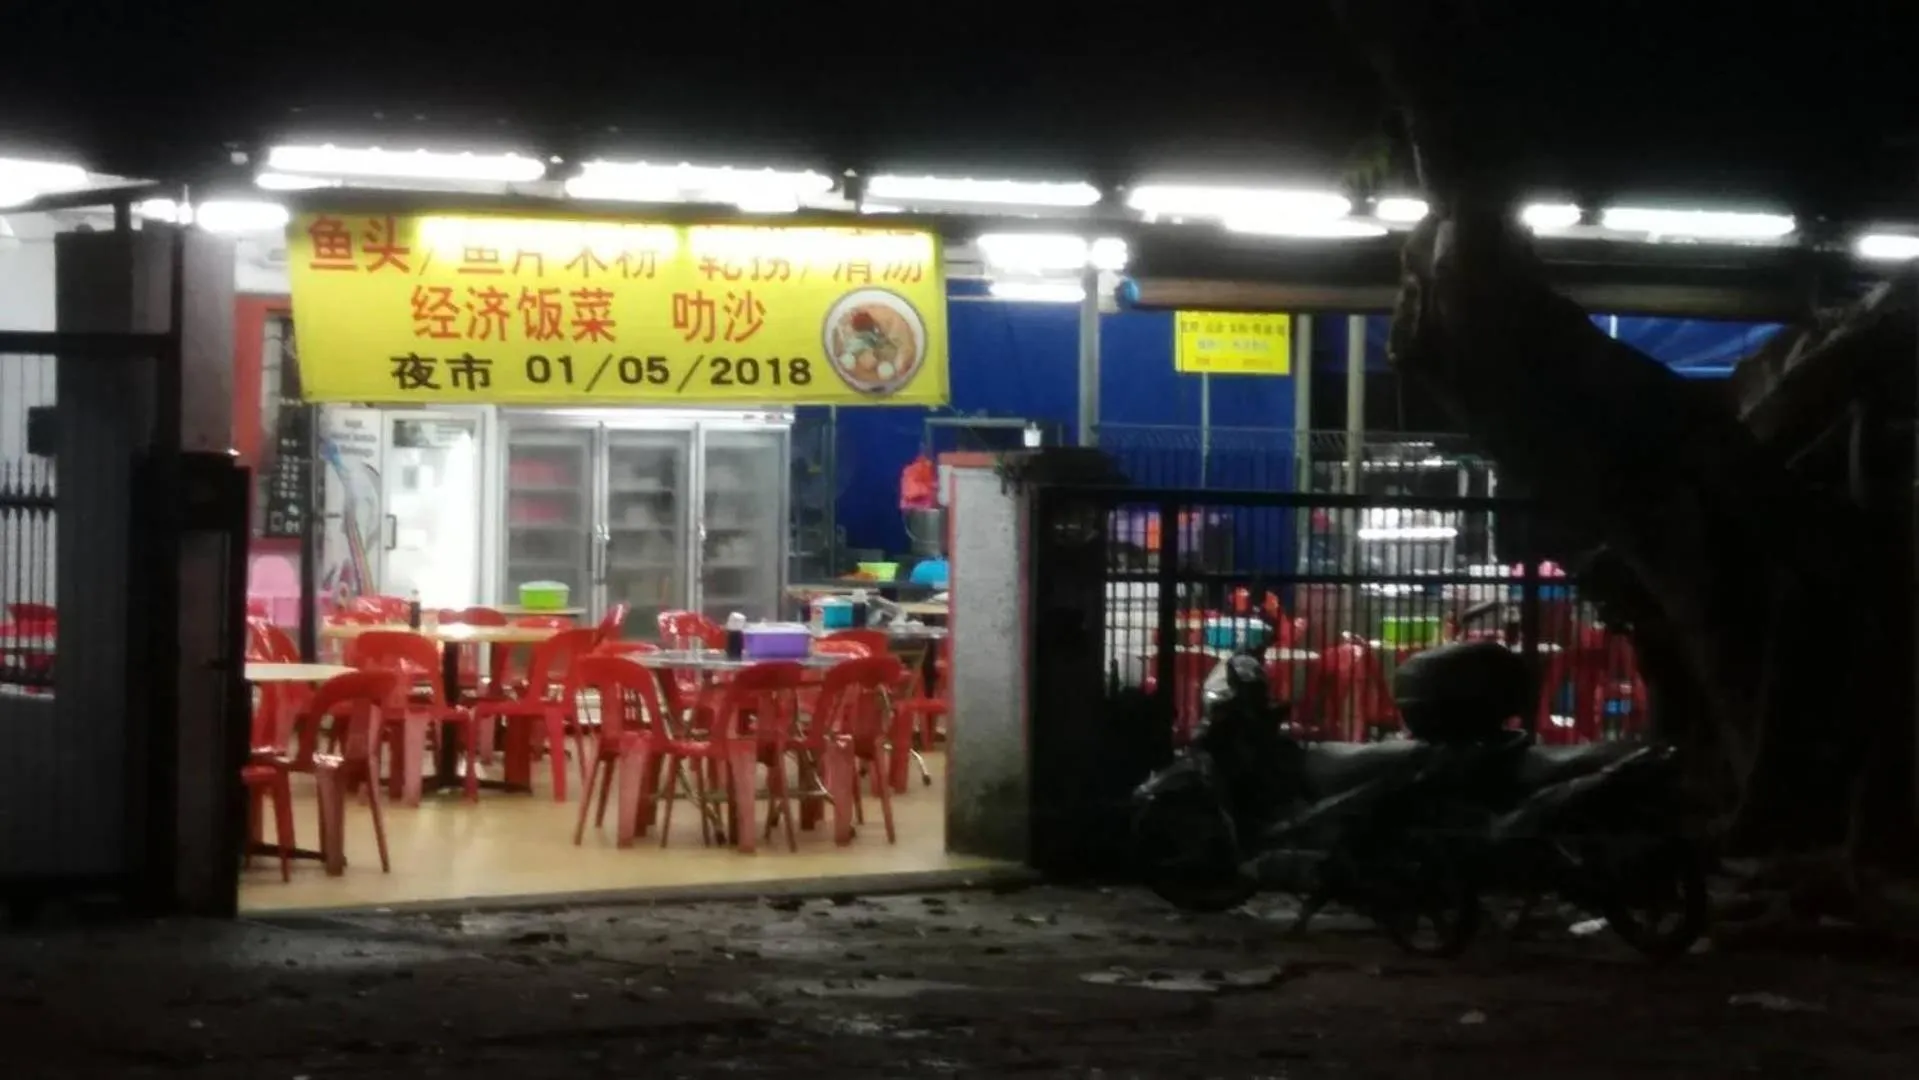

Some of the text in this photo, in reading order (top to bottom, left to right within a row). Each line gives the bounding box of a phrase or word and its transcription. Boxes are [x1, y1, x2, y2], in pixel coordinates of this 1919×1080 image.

[411, 285, 767, 344] 经济饭菜 叻沙
[390, 352, 812, 394] 夜市 01/05/2018
